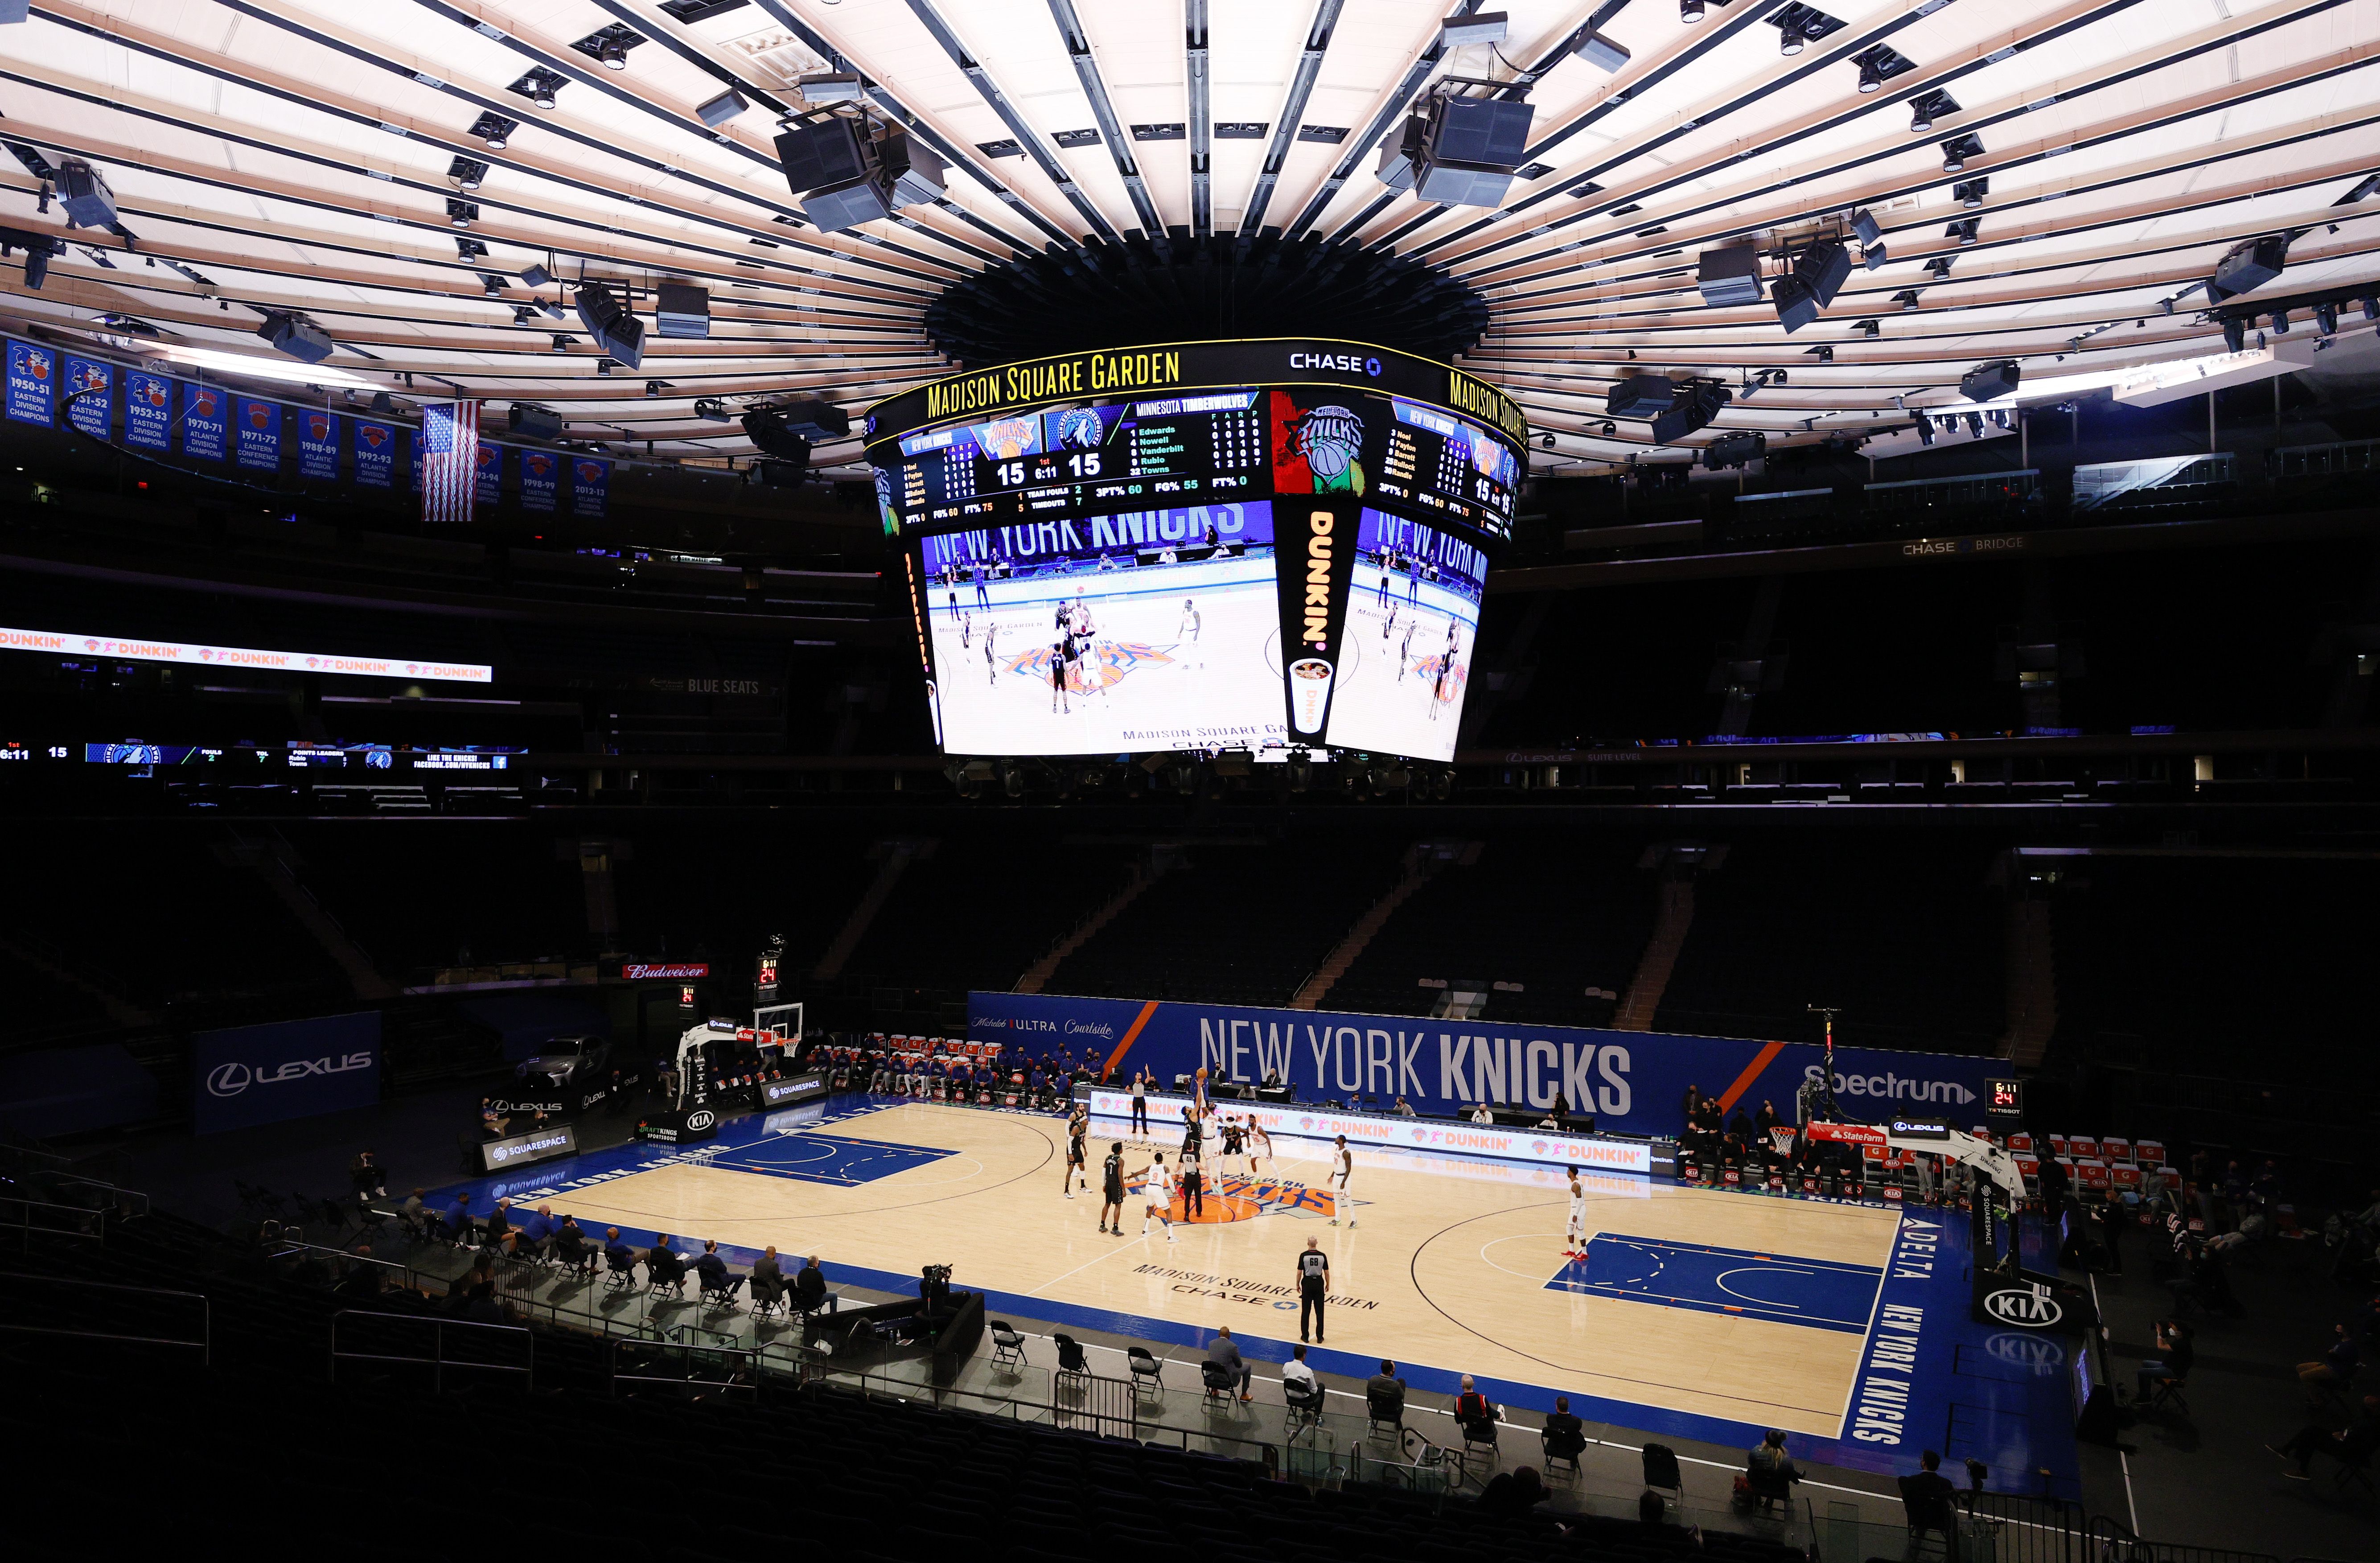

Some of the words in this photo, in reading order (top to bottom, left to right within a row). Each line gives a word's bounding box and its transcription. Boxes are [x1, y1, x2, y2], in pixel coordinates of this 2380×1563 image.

[1290, 353, 1362, 372] CHASE
[11, 377, 49, 395] 1950-51
[928, 374, 999, 418] MADISON
[1007, 361, 1082, 401] SQUARE
[1092, 352, 1179, 389] GARDEN
[15, 391, 46, 404] EASTERN
[69, 391, 107, 408] 51-52
[16, 401, 44, 413] DIVISION
[71, 405, 103, 418] EASTERN
[1136, 400, 1181, 417] MINNESOTA
[1181, 394, 1248, 412] TIMBERWOLVES
[1451, 371, 1498, 423] MADISON
[1500, 395, 1522, 441] SQUARE
[10, 408, 49, 423] CHAMPIONS
[129, 405, 167, 421] 1952-53
[72, 413, 101, 426] DIVISION
[133, 419, 163, 430] EASTERN
[187, 418, 222, 432] 1970-71
[74, 423, 107, 435] AMPIONS
[134, 427, 161, 438] DIVISION
[990, 421, 1029, 440] KNICKS
[1139, 427, 1176, 436] Edwards
[128, 434, 166, 447] CHAMPIONS
[190, 431, 219, 442] ATLANTIC
[241, 430, 276, 444] 1971-72
[1139, 436, 1169, 446] Nowell
[1397, 431, 1411, 441] Noel
[191, 439, 217, 449] DIVISION
[244, 443, 272, 453] EASTERN
[301, 441, 336, 455] 1988-89
[1396, 440, 1416, 452] Payton
[186, 446, 222, 458] CHAMPIONS
[238, 449, 279, 461] CONFERENCE
[1140, 445, 1184, 456] Vanderbilt
[1394, 450, 1415, 461] Barrett
[240, 457, 276, 469] CHAMPIONS
[305, 453, 333, 463] ATLANTIC
[358, 451, 391, 464] 1992-93
[1141, 457, 1165, 465] Rubio
[306, 461, 331, 470] DIVISION
[360, 463, 387, 472] ATLANTIC
[1069, 452, 1101, 477] 15
[1393, 459, 1415, 471] Bullock
[301, 468, 336, 478] CHAMPIONS
[362, 470, 386, 479] DIVISION
[908, 471, 923, 480] Payton
[997, 462, 1024, 485] 15
[1035, 466, 1056, 479] 6:11
[1130, 468, 1141, 476] 32
[1141, 466, 1170, 475] Towns
[1392, 469, 1412, 480] Randle
[357, 477, 390, 487] CHAMPIONS
[524, 478, 555, 489] 1998-99
[1155, 481, 1180, 492] FG%
[1184, 480, 1198, 489] 55
[1212, 477, 1237, 487] FT%
[526, 489, 551, 498] EASTERN
[1027, 489, 1045, 498] TEAM
[1047, 487, 1069, 496] FOULS
[1096, 486, 1125, 497] 3PT%
[1128, 485, 1142, 494] 60
[1476, 478, 1489, 501] 15
[521, 495, 556, 505] CONFERENCE
[911, 497, 925, 506] Randle
[1031, 499, 1065, 509] TIMEOUTS
[523, 502, 554, 511] CHAMPIONS
[965, 504, 981, 514] FT%
[982, 502, 993, 512] 75
[906, 514, 920, 524] 3PT%
[933, 509, 948, 519] FG%
[949, 507, 958, 517] 60
[1001, 518, 1082, 557] YORK
[1092, 504, 1245, 548] KNICKS
[1903, 542, 1955, 555] CHASE
[1976, 538, 2022, 550] BRIDGE
[1302, 511, 1334, 651] DUNKIN'
[0, 633, 66, 649] DUNKIN'
[118, 643, 181, 658] DUNKIN'
[231, 652, 289, 666] DUNKIN'
[335, 660, 390, 672] DUNKIN'
[434, 667, 486, 679] DUNKIN'
[688, 679, 719, 692] BLUE
[723, 680, 759, 694] SEATS
[1123, 730, 1191, 740] MADISON
[1198, 726, 1260, 736] SQUARE
[1173, 739, 1254, 749] CHASE
[0, 749, 29, 760] 6:11
[49, 747, 67, 757] 15
[628, 964, 704, 979] Budweiser
[760, 968, 774, 983] 24
[971, 1017, 1006, 1028] Michelob
[1016, 1019, 1056, 1032] ULTRA
[1065, 1019, 1114, 1040] Courtside
[256, 1051, 372, 1084] LEXUS
[1200, 1018, 1294, 1085] NEW
[1307, 1025, 1425, 1097] YORK
[1439, 1034, 1631, 1115] KNICKS
[780, 1080, 820, 1096] SQUARESPACE
[1804, 1065, 1964, 1105] Spectrum
[1995, 1082, 2017, 1093] 6:11
[1995, 1092, 2013, 1105] 24
[511, 1103, 563, 1111] LEXUS
[692, 1114, 710, 1127] KIA
[800, 1103, 896, 1127] DELTA
[639, 1126, 677, 1135] DRAFTKINGS
[1331, 1120, 1393, 1139] DUNKIN'
[1907, 1124, 1945, 1132] LEXUS
[647, 1133, 676, 1142] SPORTSBOOK
[1445, 1132, 1513, 1152] DUNKIN'
[1842, 1131, 1883, 1143] StateFarm
[510, 1135, 567, 1156] SQUARESPACE
[1568, 1144, 1640, 1164] DUNKIN'
[559, 1168, 637, 1189] YORK
[637, 1144, 731, 1169] KNICKS
[1110, 1164, 1113, 1175] 1
[1979, 1156, 2002, 1174] SPALDING
[1152, 1172, 1158, 1181] 9
[1885, 1189, 1900, 1197] KIA
[1983, 1197, 1992, 1245] SQUARESPACE
[1893, 1231, 1938, 1279] DELTA
[1310, 1257, 1318, 1267] 68
[1132, 1263, 1220, 1284] MADISON
[1221, 1277, 1297, 1297] SQUARE
[1299, 1293, 1380, 1310] RDEN
[1171, 1285, 1270, 1305] CHASE
[1998, 1297, 2050, 1321] KIA
[1880, 1304, 1924, 1333] NEW
[1870, 1334, 1919, 1374] YORK
[1852, 1376, 1911, 1446] KNICKS
